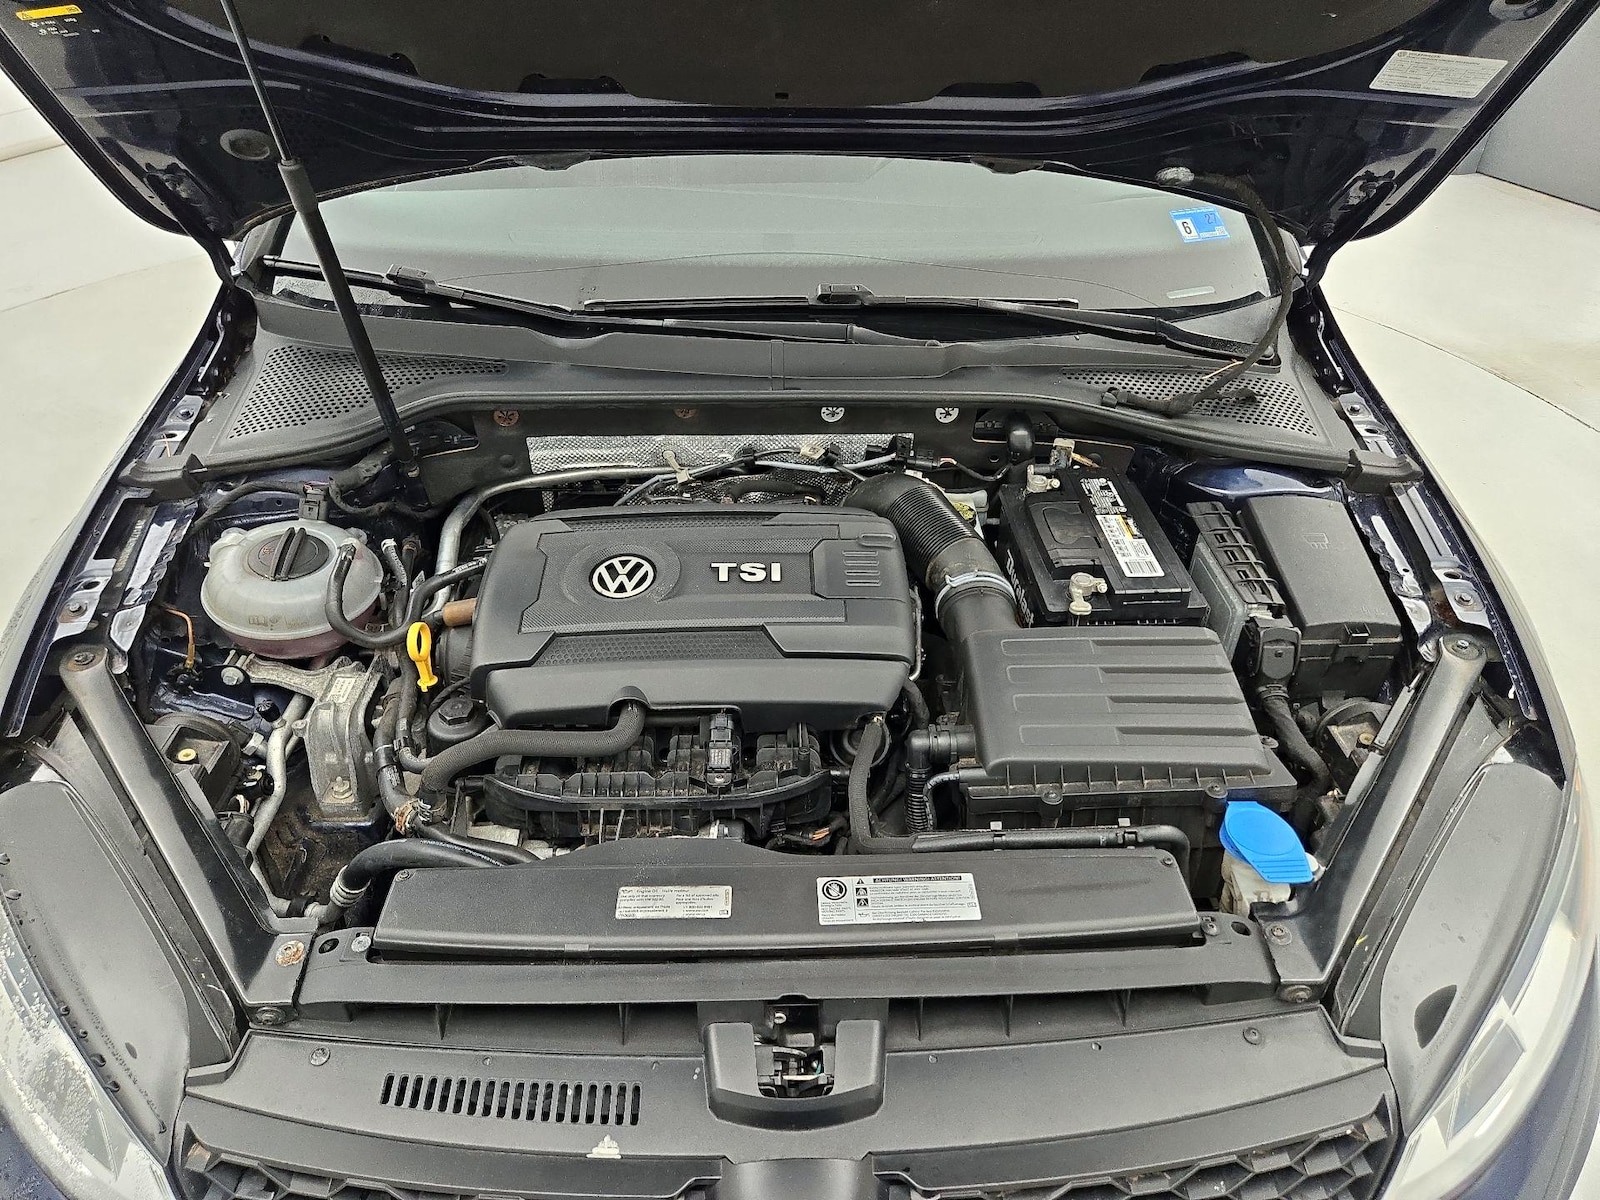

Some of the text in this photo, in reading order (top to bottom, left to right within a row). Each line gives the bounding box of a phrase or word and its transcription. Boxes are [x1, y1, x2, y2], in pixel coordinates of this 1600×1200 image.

[1181, 221, 1193, 235] 6
[710, 562, 782, 582] TSI
[1006, 549, 1035, 626] Duralast
